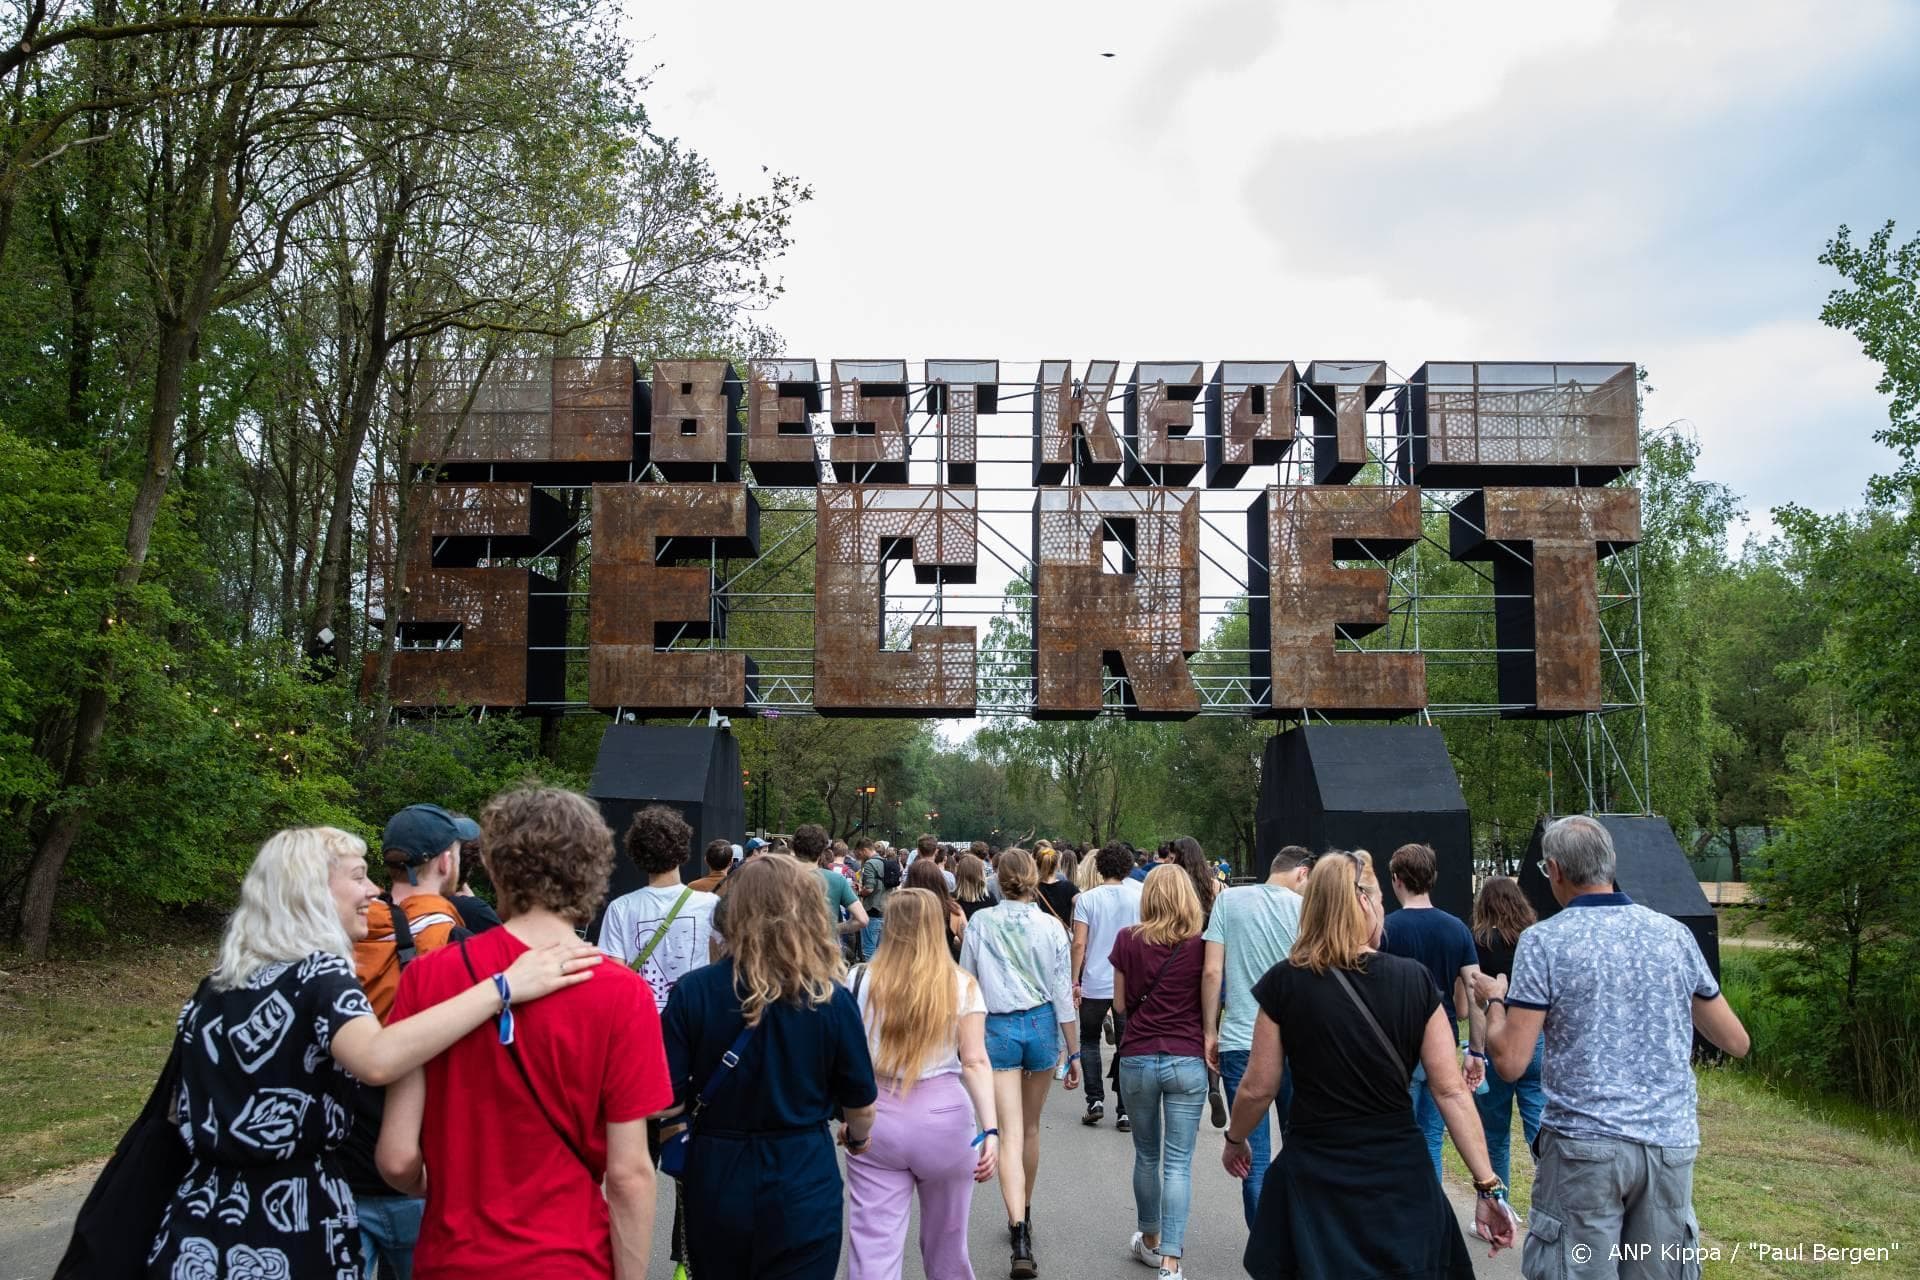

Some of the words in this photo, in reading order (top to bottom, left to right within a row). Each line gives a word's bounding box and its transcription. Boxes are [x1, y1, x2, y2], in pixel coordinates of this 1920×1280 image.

[650, 358, 999, 463] BEST
[1041, 360, 1386, 465] KEPT
[362, 482, 1640, 711] SECRET
